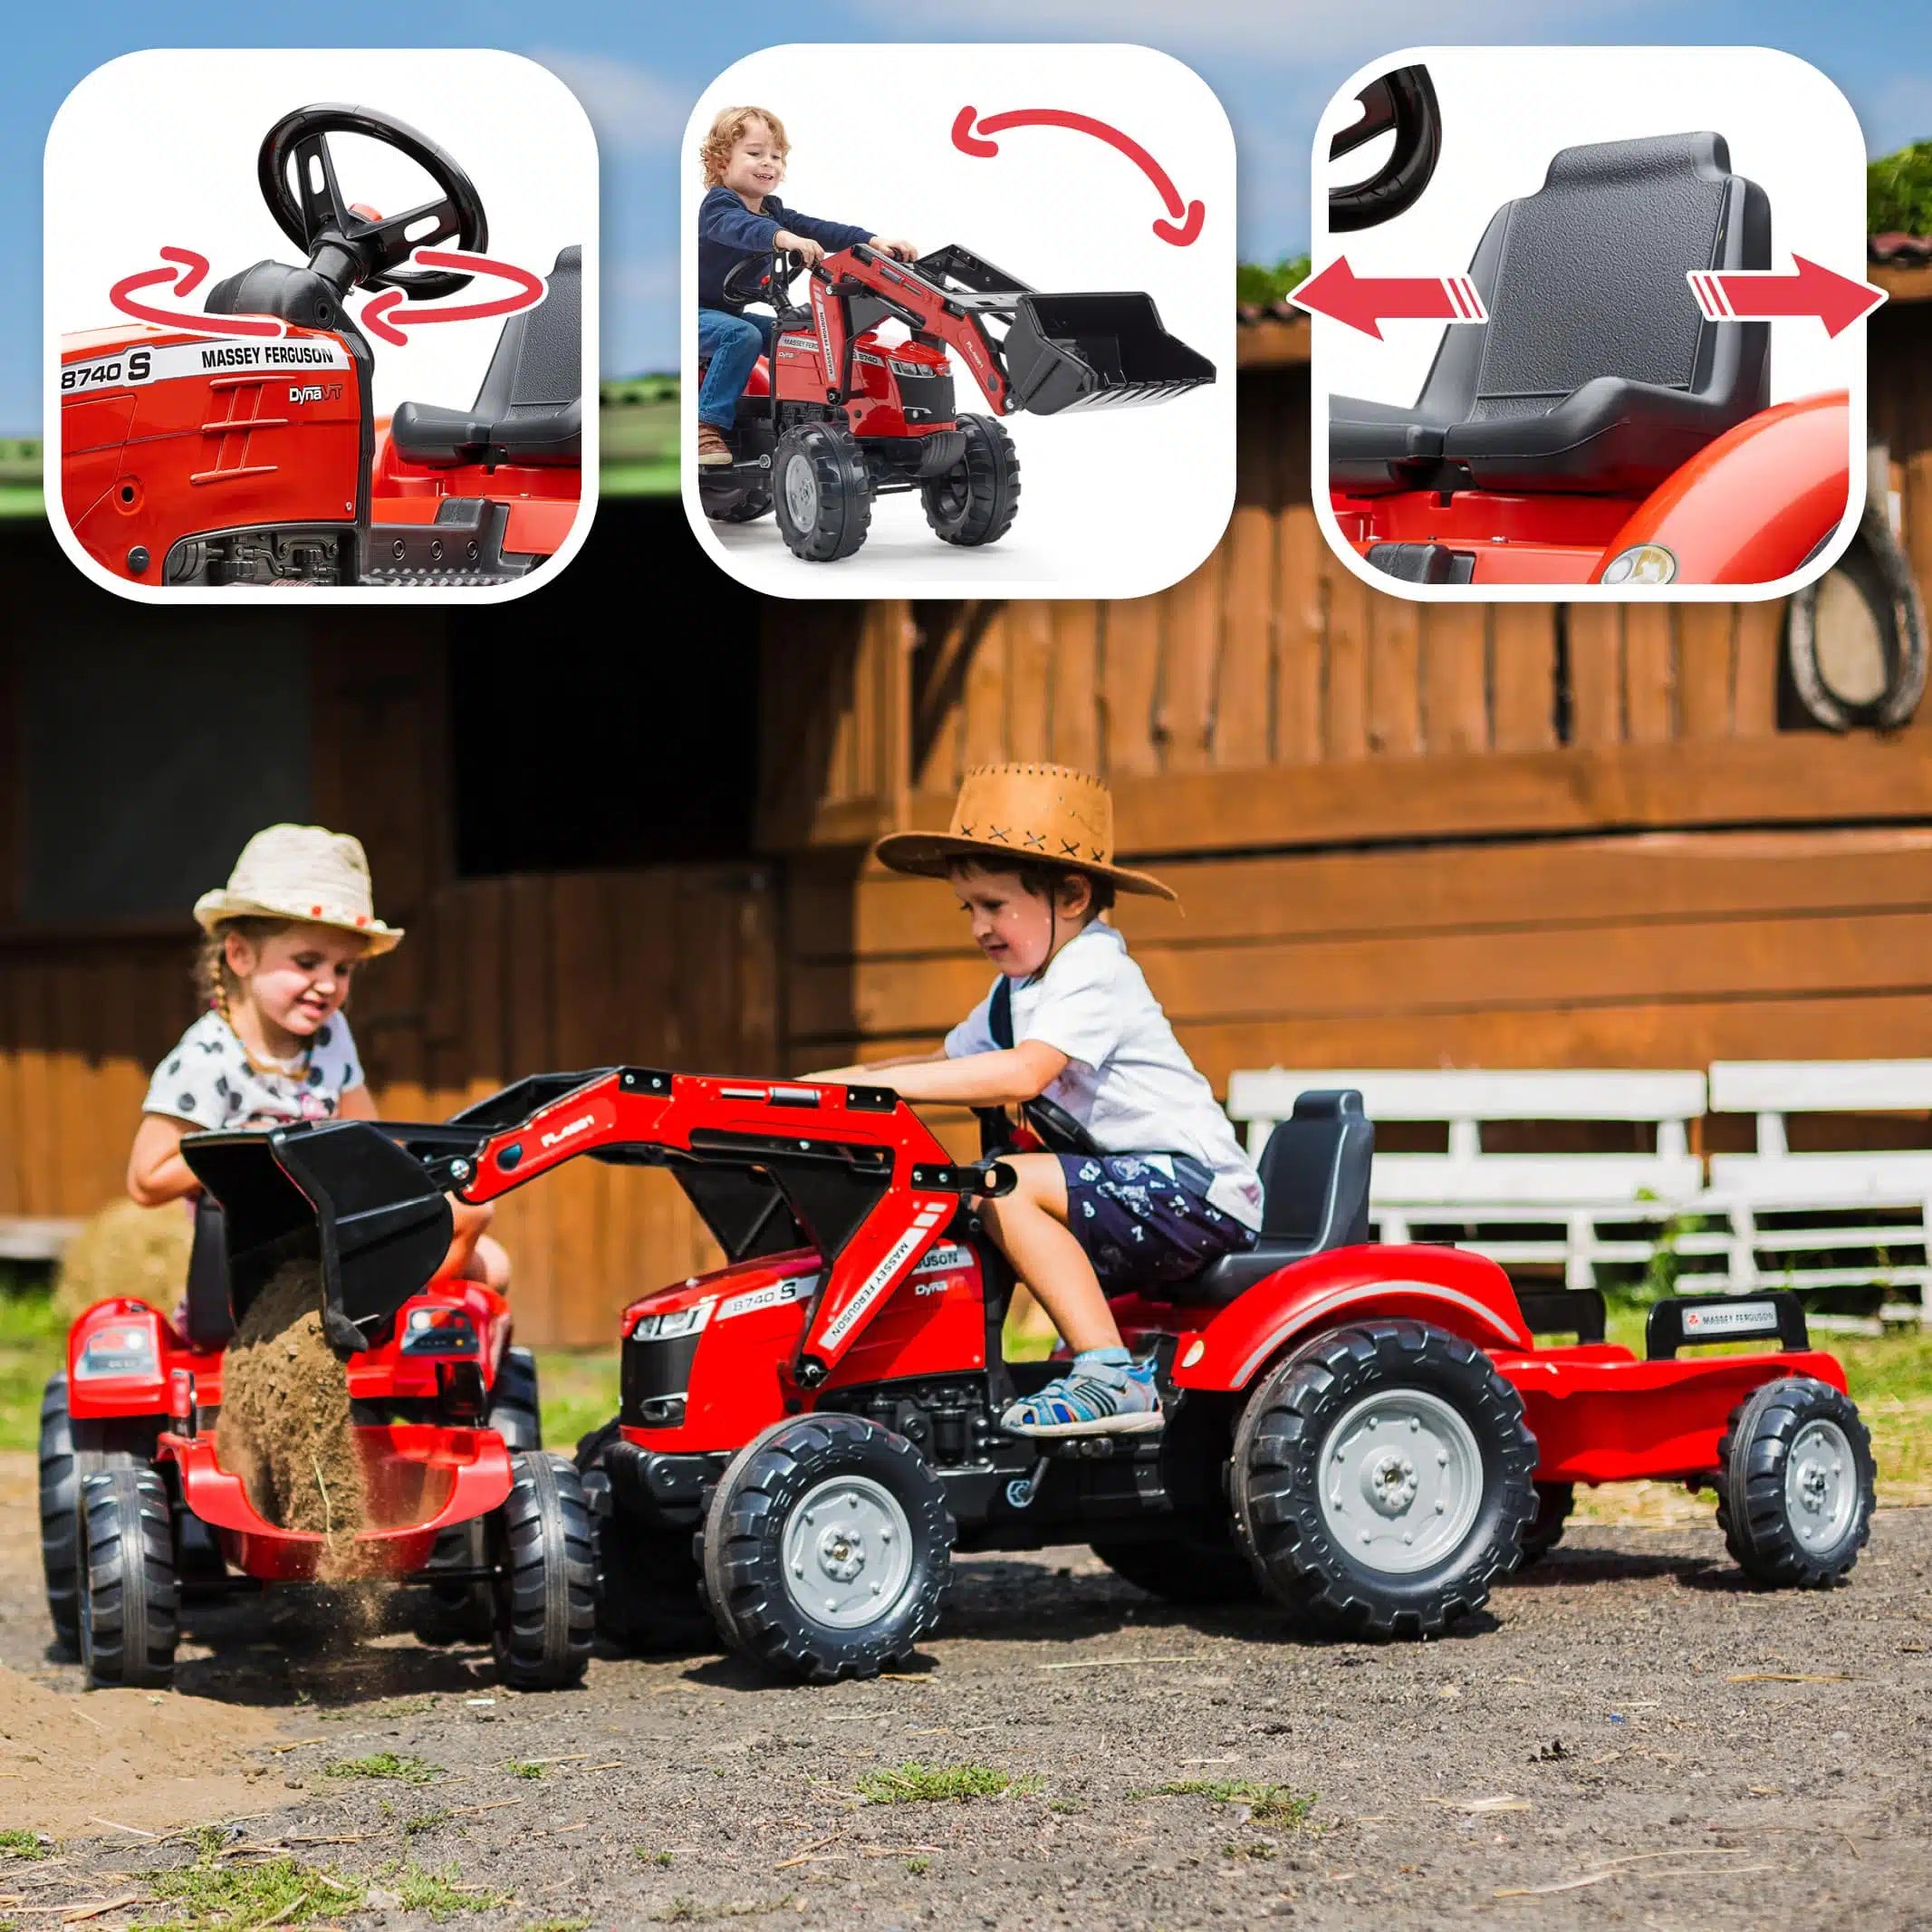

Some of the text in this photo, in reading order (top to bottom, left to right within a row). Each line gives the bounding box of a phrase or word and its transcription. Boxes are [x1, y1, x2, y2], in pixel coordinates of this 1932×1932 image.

[61, 346, 334, 389] 8740 S MASSEY FERGUSON
[733, 1282, 796, 1312] 8740 S
[831, 1242, 909, 1337] MASSEY FERGUSON
